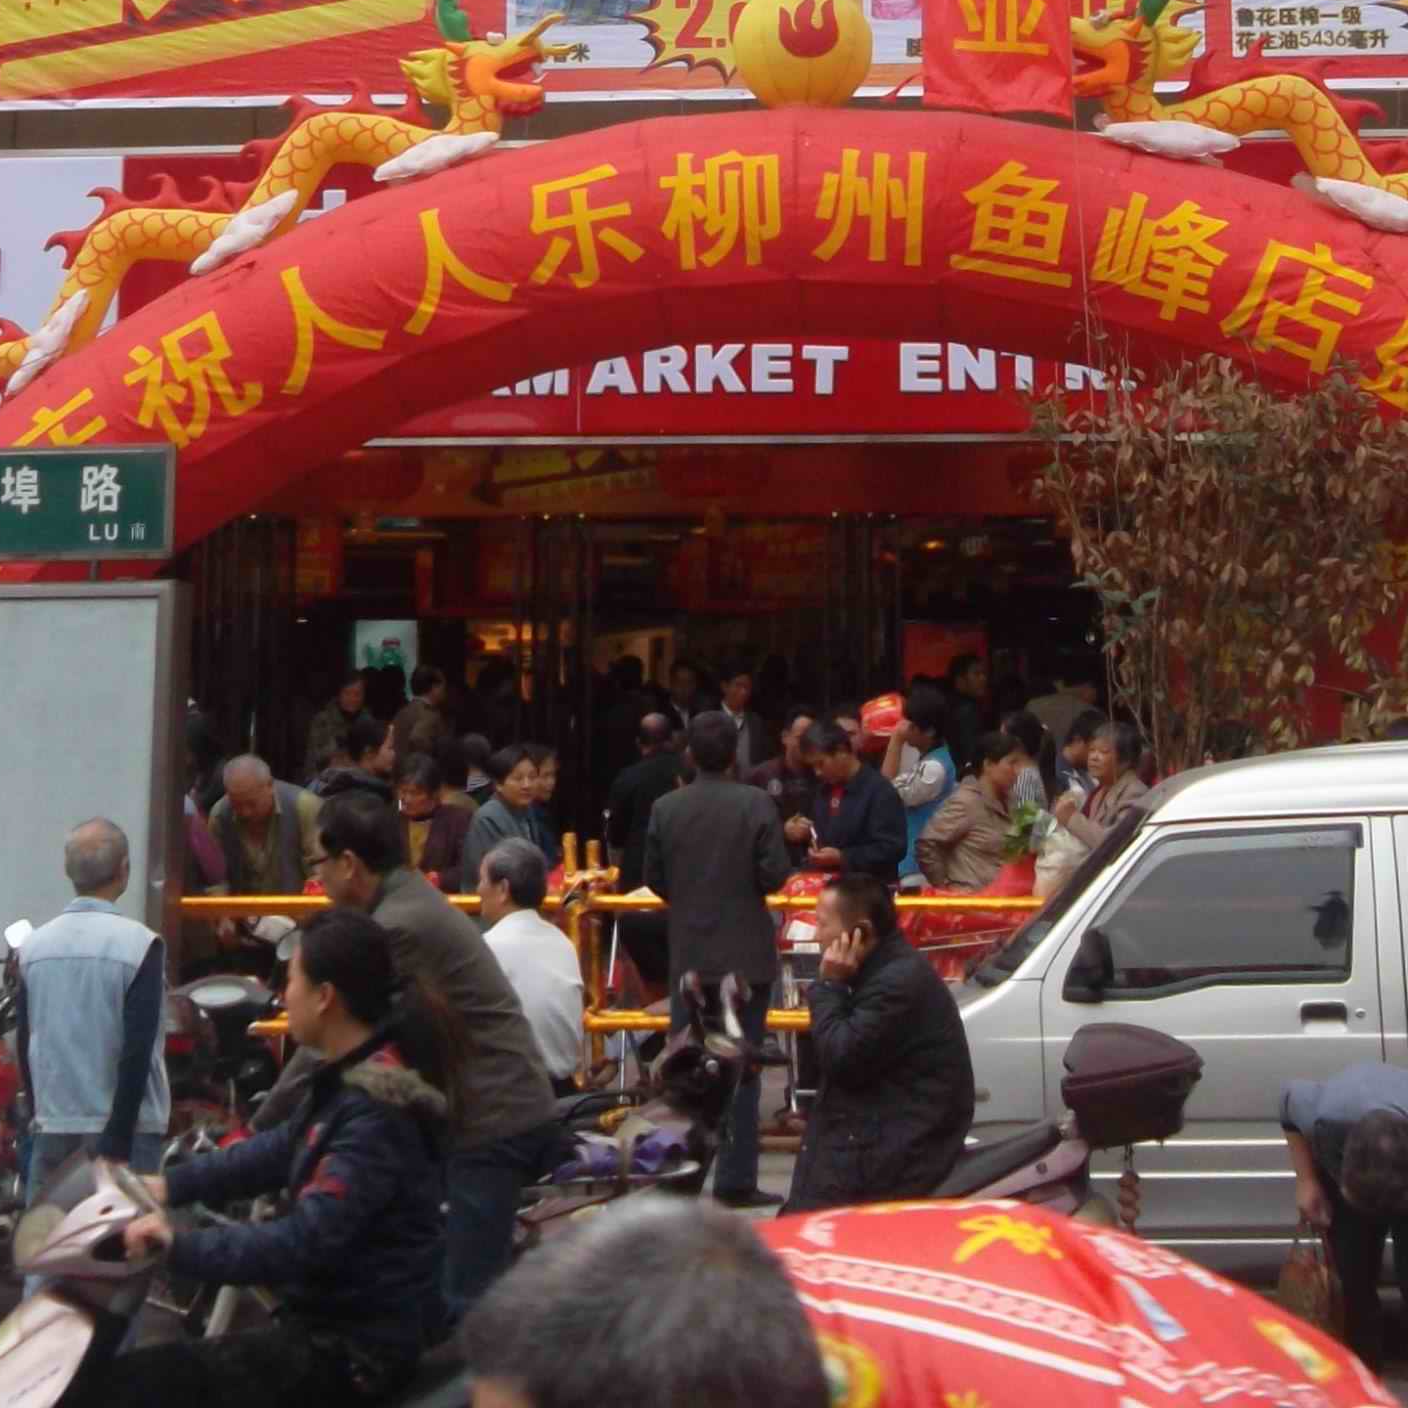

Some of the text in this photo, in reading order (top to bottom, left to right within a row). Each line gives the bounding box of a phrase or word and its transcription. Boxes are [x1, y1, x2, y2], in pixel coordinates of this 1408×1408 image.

[492, 343, 850, 396] MARKET
[88, 522, 119, 542] LU
[129, 521, 146, 542] 南
